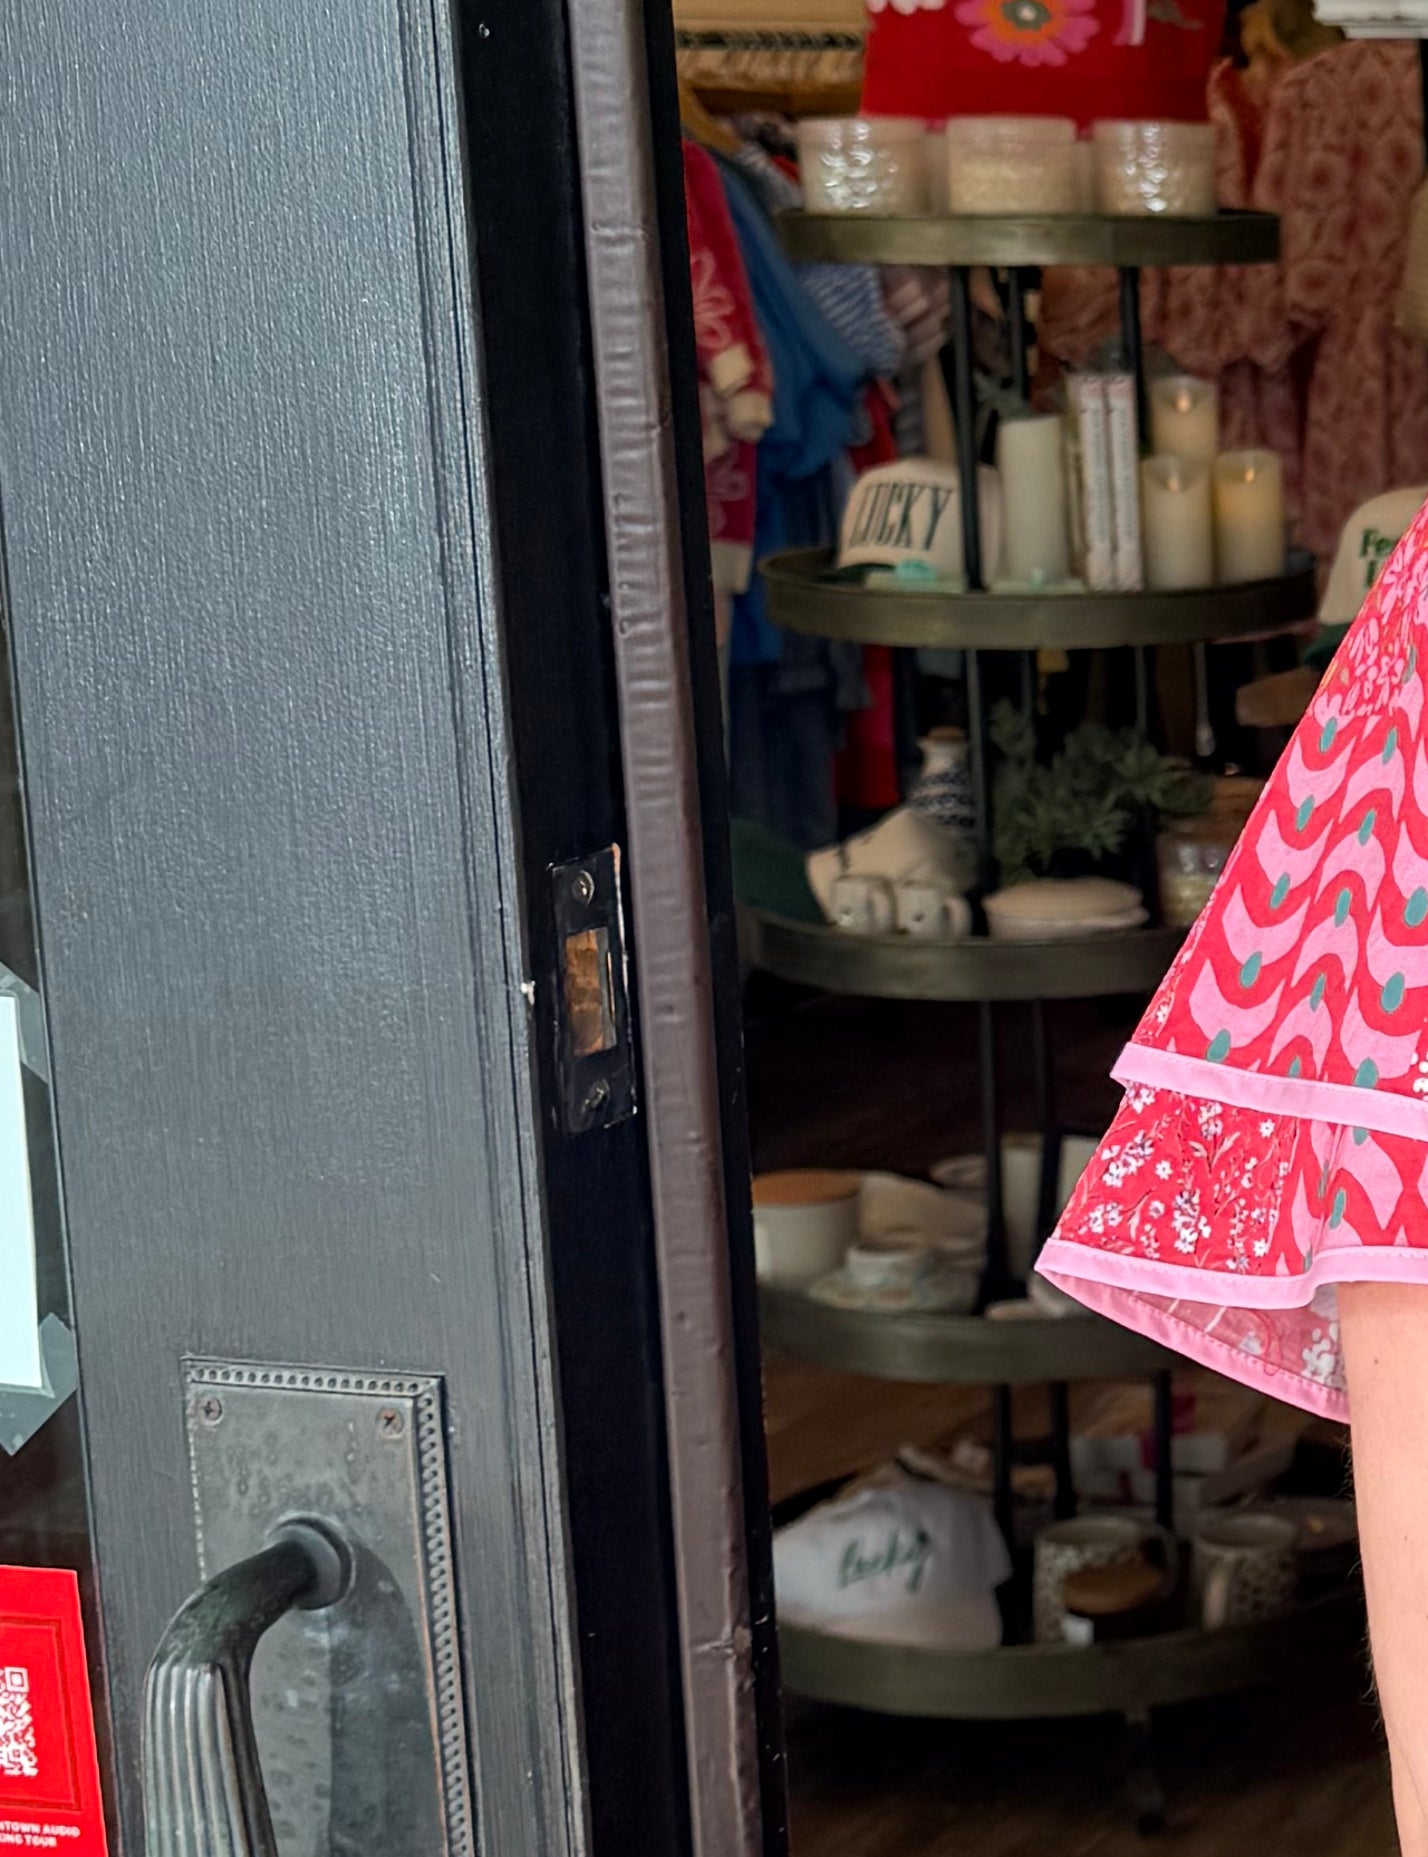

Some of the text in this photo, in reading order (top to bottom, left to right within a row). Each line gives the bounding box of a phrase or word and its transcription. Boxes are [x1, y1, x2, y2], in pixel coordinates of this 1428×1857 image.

[849, 482, 955, 551] LUCKY
[42, 1823, 81, 1838] AUDIO
[24, 1834, 57, 1848] TOUR
